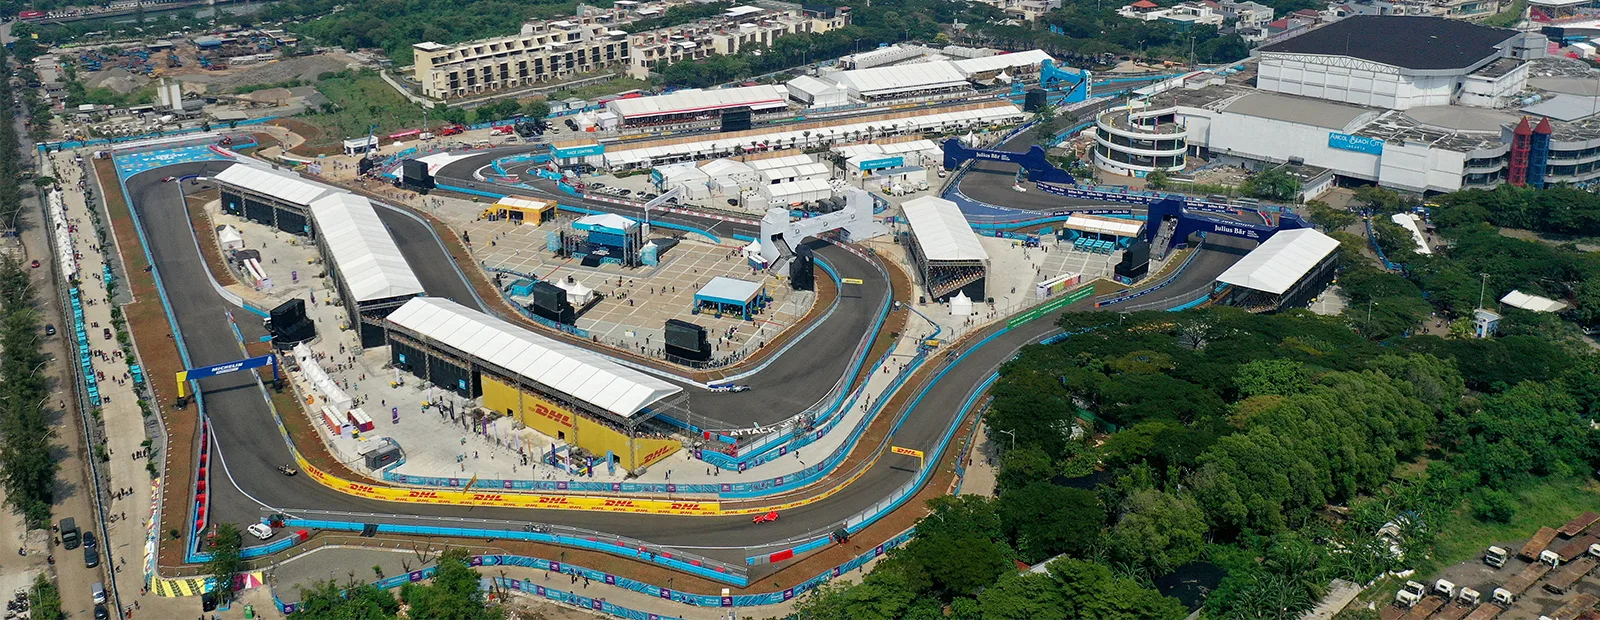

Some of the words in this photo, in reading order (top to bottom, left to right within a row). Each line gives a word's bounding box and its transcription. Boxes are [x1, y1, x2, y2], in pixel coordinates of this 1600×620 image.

[1215, 225, 1233, 233] Julius
[212, 362, 243, 372] MICHELIN
[535, 404, 572, 427] DHL
[730, 426, 777, 436] ATTACK
[643, 445, 669, 464] DHL
[308, 466, 324, 479] DHL
[349, 483, 375, 493] DHL
